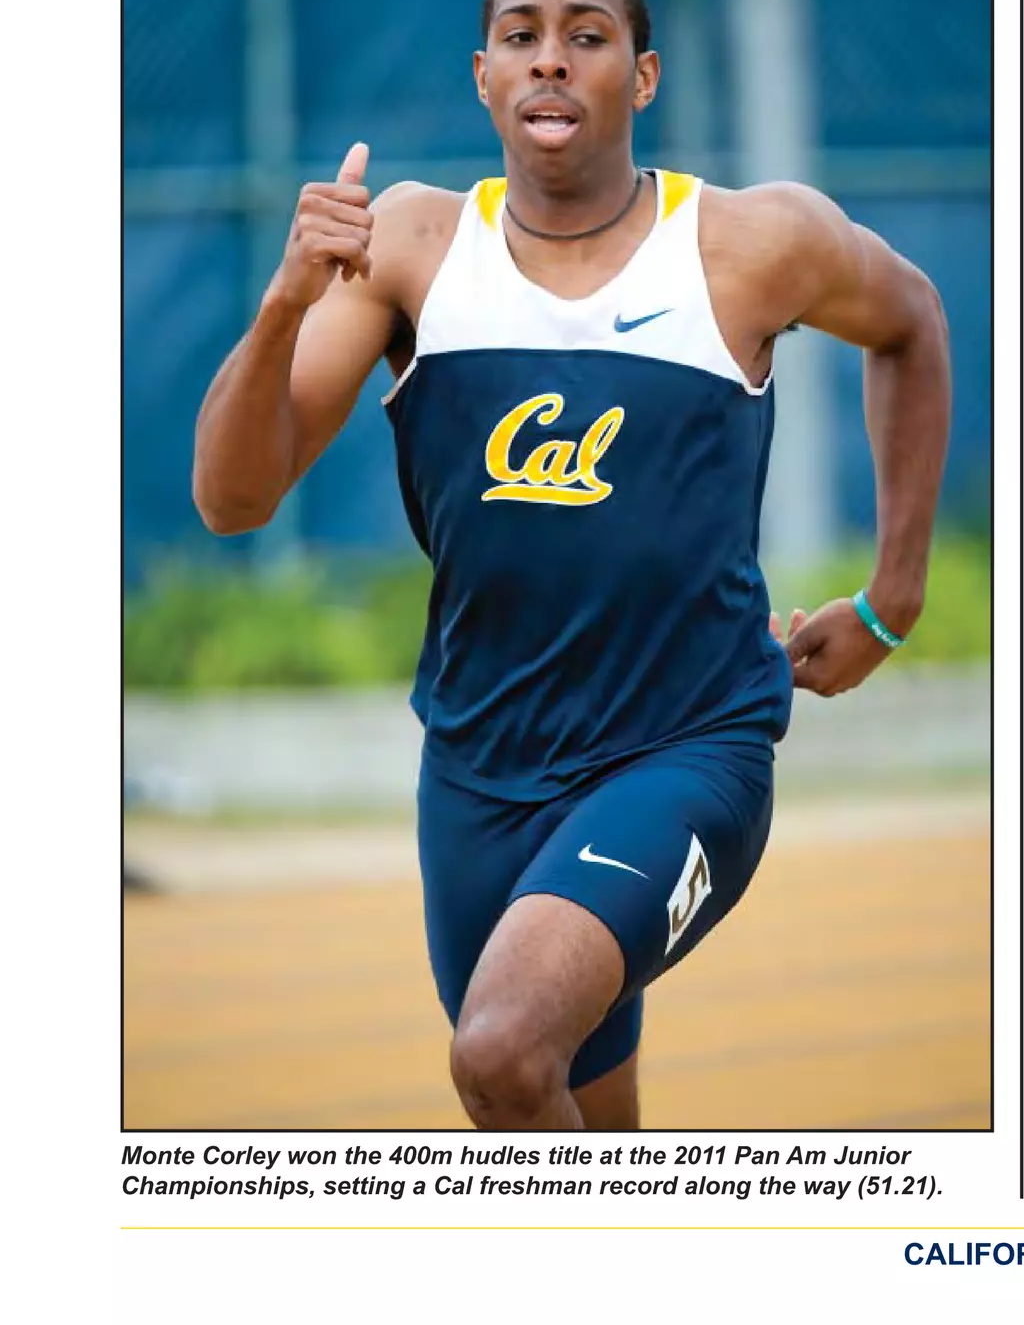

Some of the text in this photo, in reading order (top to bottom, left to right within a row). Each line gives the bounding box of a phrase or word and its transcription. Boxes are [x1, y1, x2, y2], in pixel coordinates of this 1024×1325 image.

[481, 392, 625, 506] Cal
[121, 1146, 912, 1170] Monte Corley won the 400m hudles title at the 2011 Pan Am Junior
[123, 1176, 942, 1200] Championships, setting a Cal freshman record along the way (51.21).
